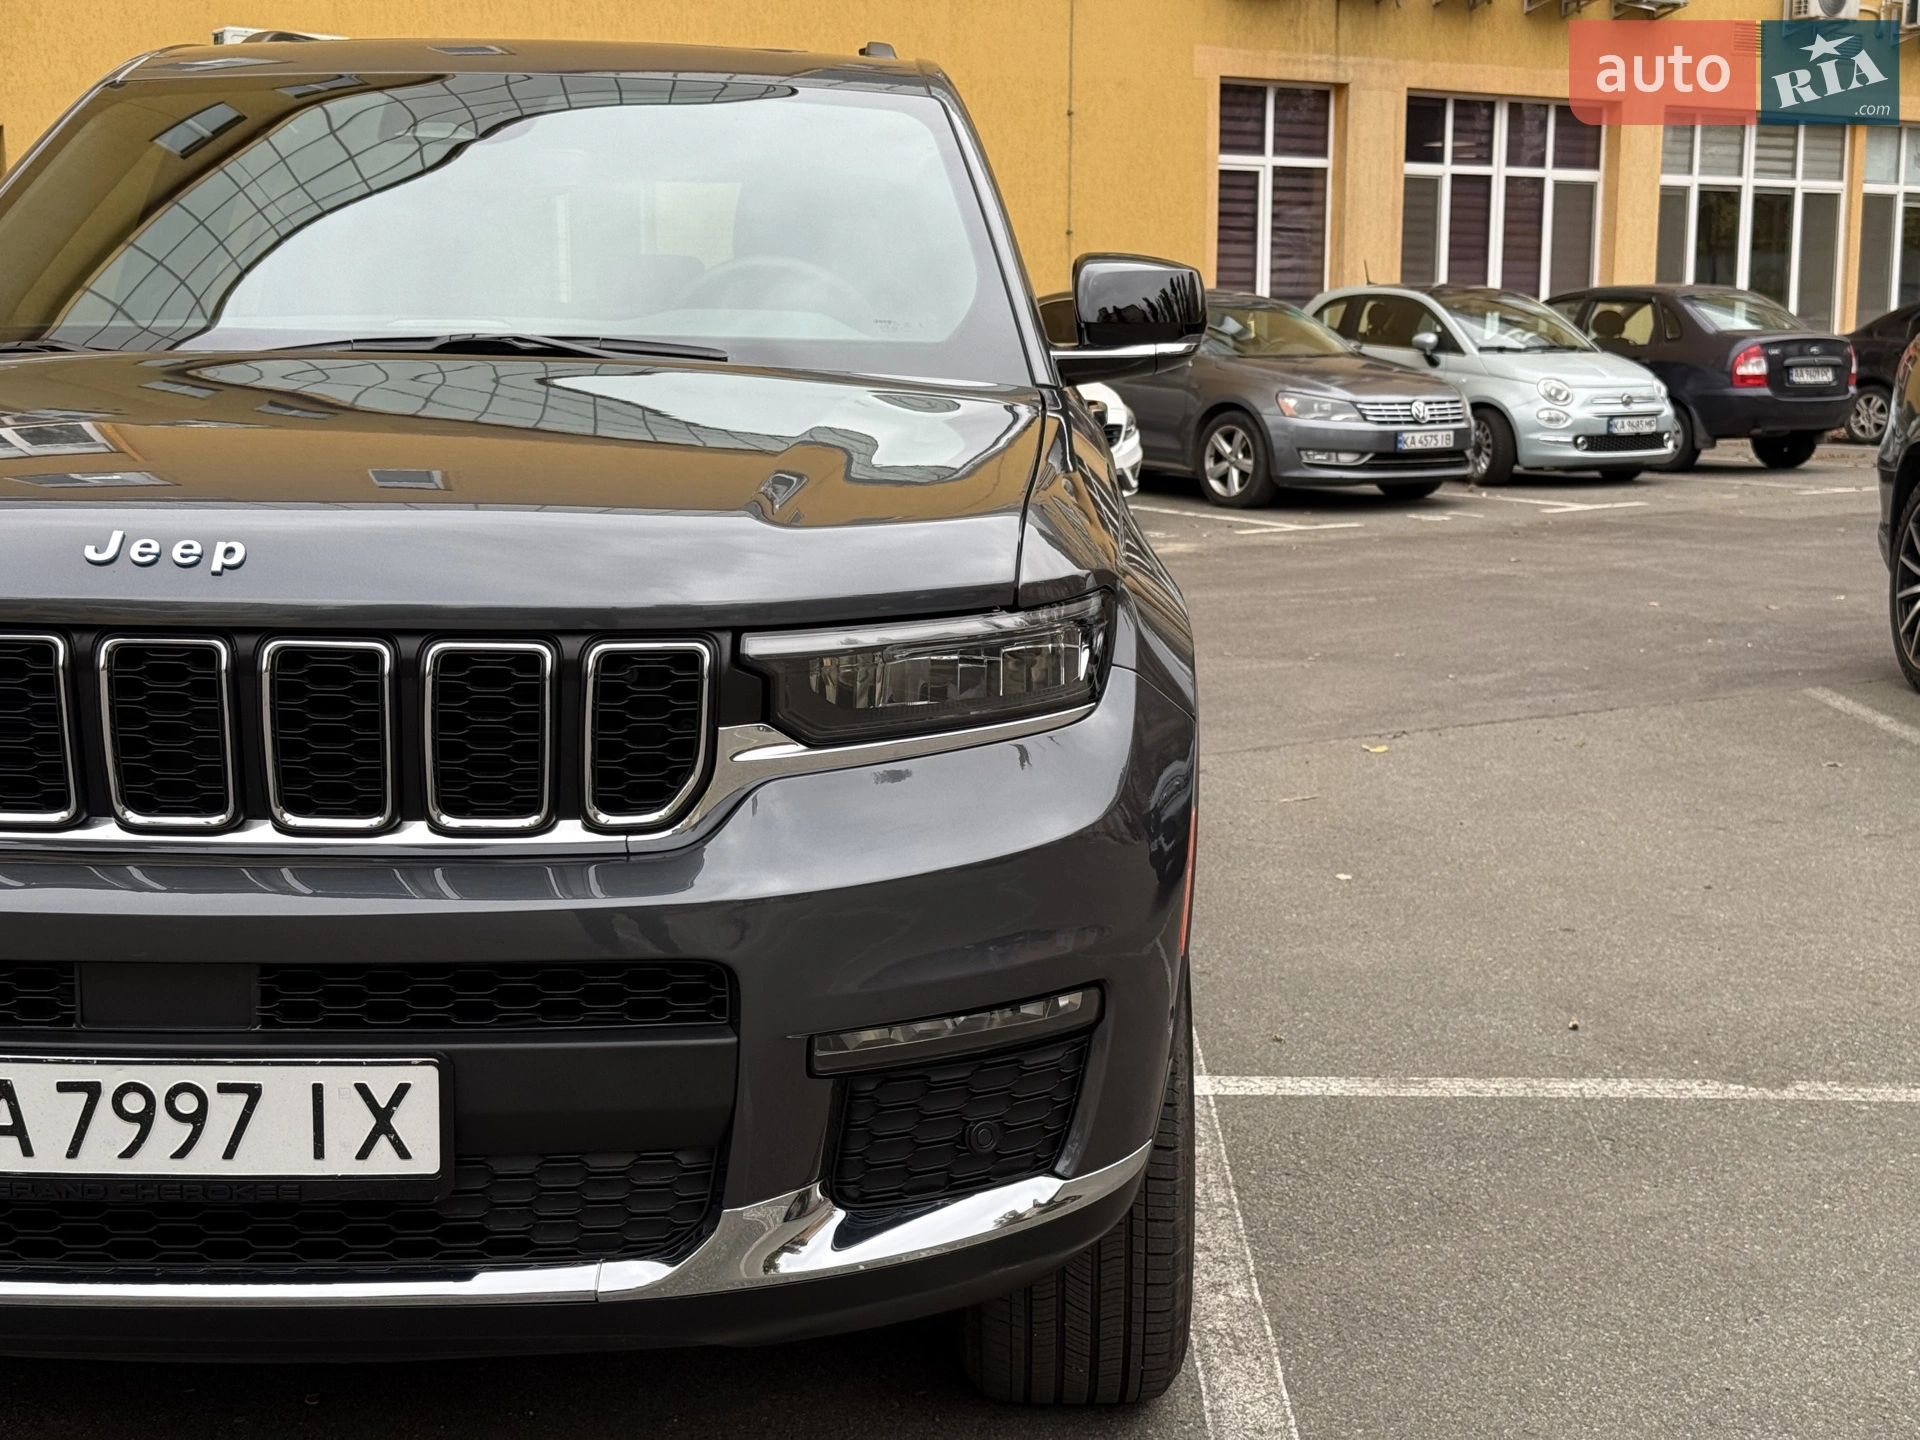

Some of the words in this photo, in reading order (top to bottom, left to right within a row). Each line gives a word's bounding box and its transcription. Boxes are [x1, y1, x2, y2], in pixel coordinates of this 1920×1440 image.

[1613, 420, 1625, 431] KA
[1403, 436, 1416, 448] KA
[1418, 434, 1439, 447] 4575
[83, 530, 247, 576] Jeep
[56, 1081, 263, 1160] 7997
[311, 1082, 413, 1160] IX
[117, 1183, 300, 1201] CHEROKEE
